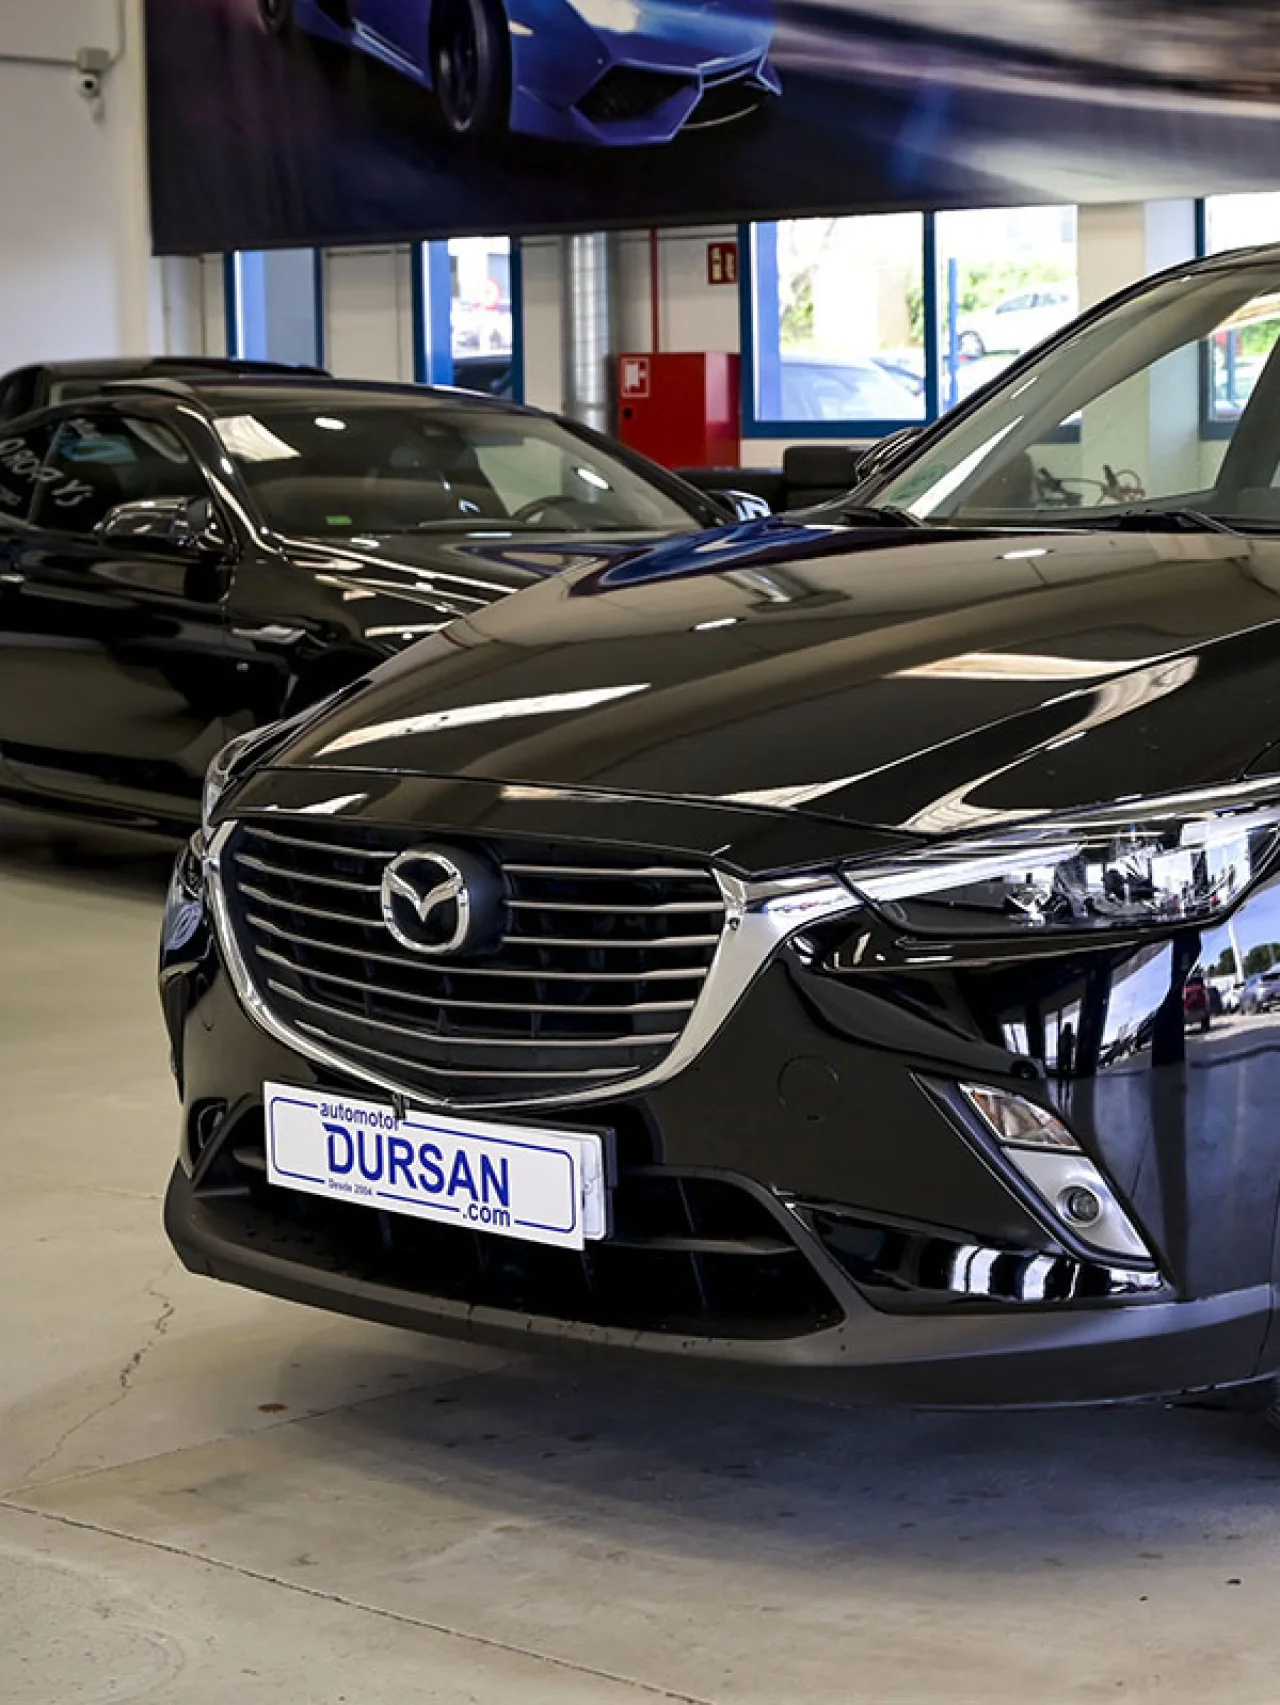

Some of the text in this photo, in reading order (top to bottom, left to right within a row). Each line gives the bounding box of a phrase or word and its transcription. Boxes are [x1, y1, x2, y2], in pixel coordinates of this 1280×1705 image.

[320, 1102, 400, 1132] automotor
[322, 1121, 509, 1207] DURSAN
[463, 1203, 511, 1227] .com
